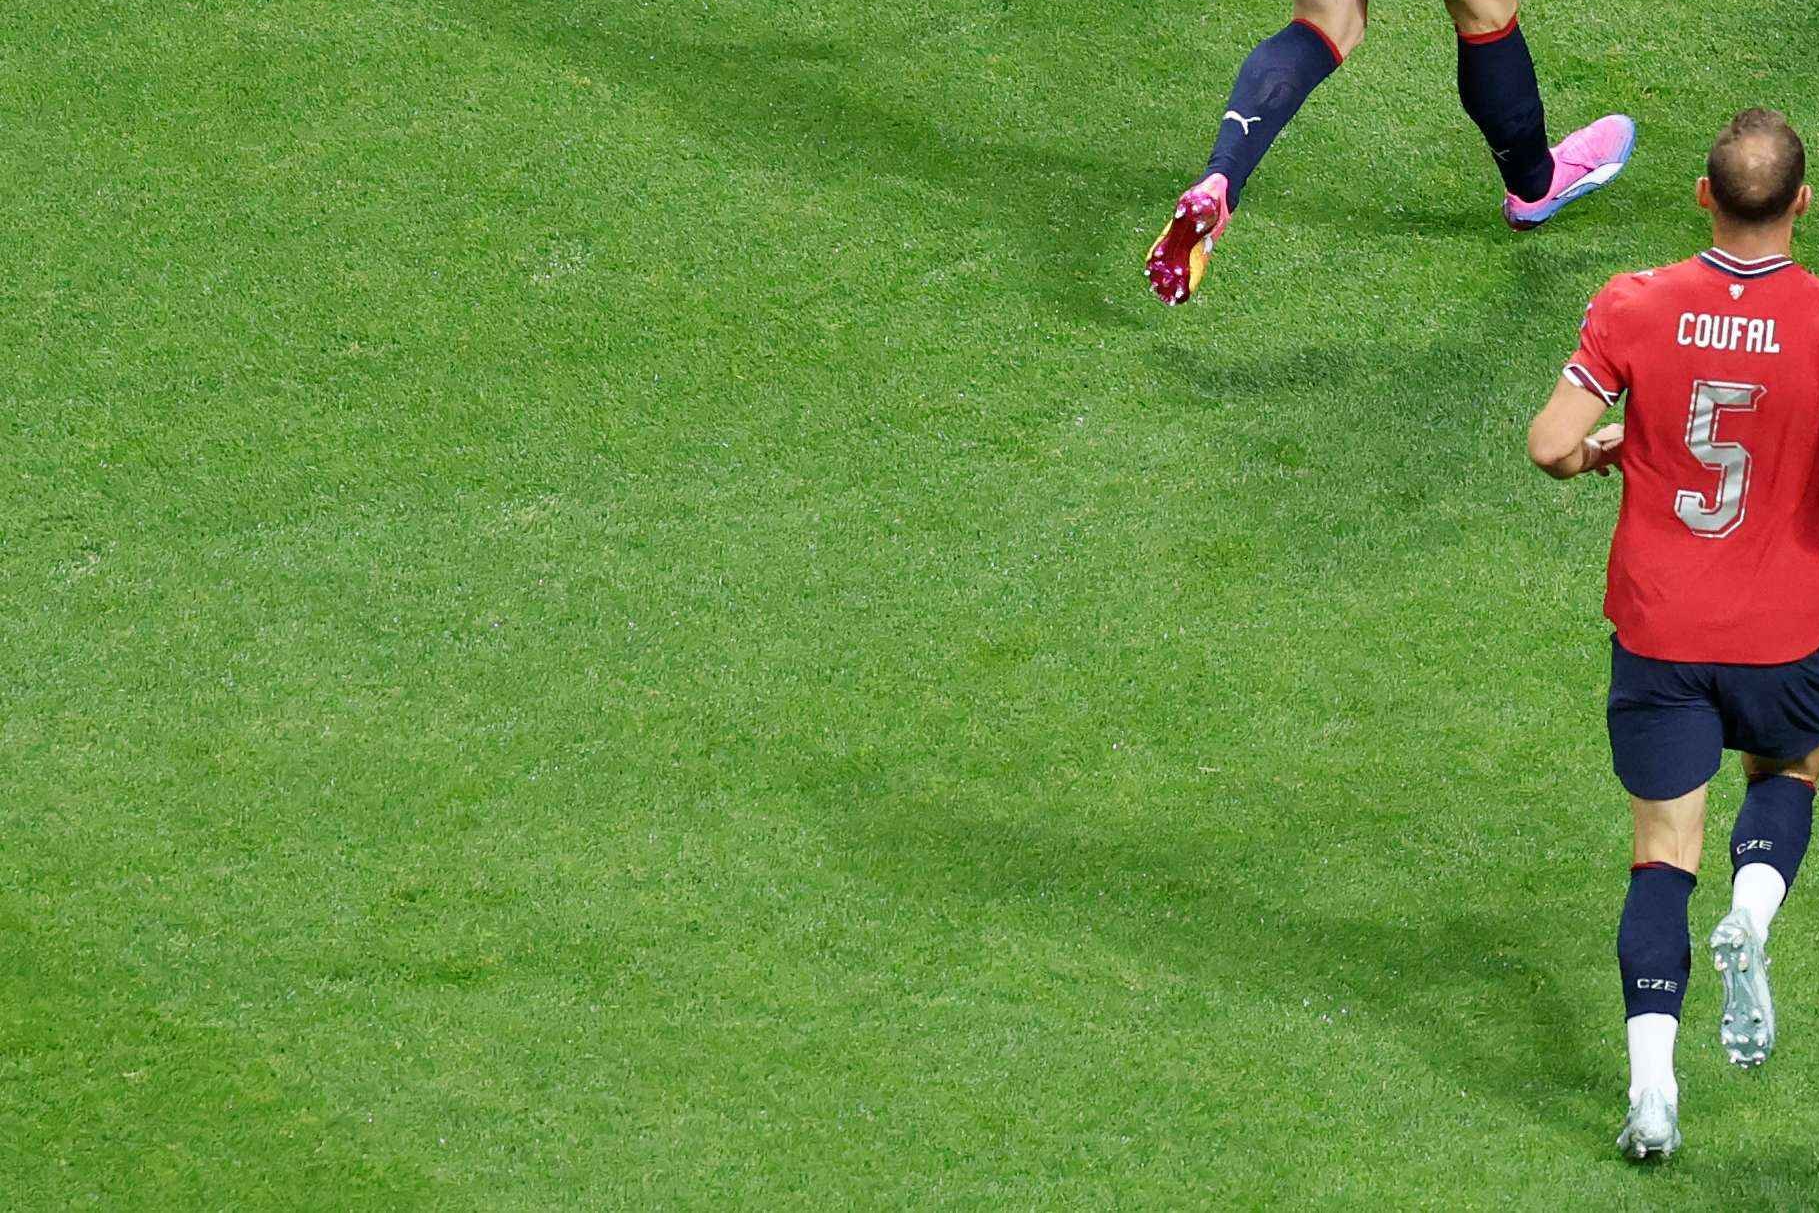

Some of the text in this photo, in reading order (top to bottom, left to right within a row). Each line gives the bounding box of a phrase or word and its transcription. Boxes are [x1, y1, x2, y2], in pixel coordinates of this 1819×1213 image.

[1677, 312, 1780, 354] COUFAL
[1674, 379, 1768, 539] 5
[1736, 839, 1773, 855] CZE
[1637, 978, 1678, 994] CZE
